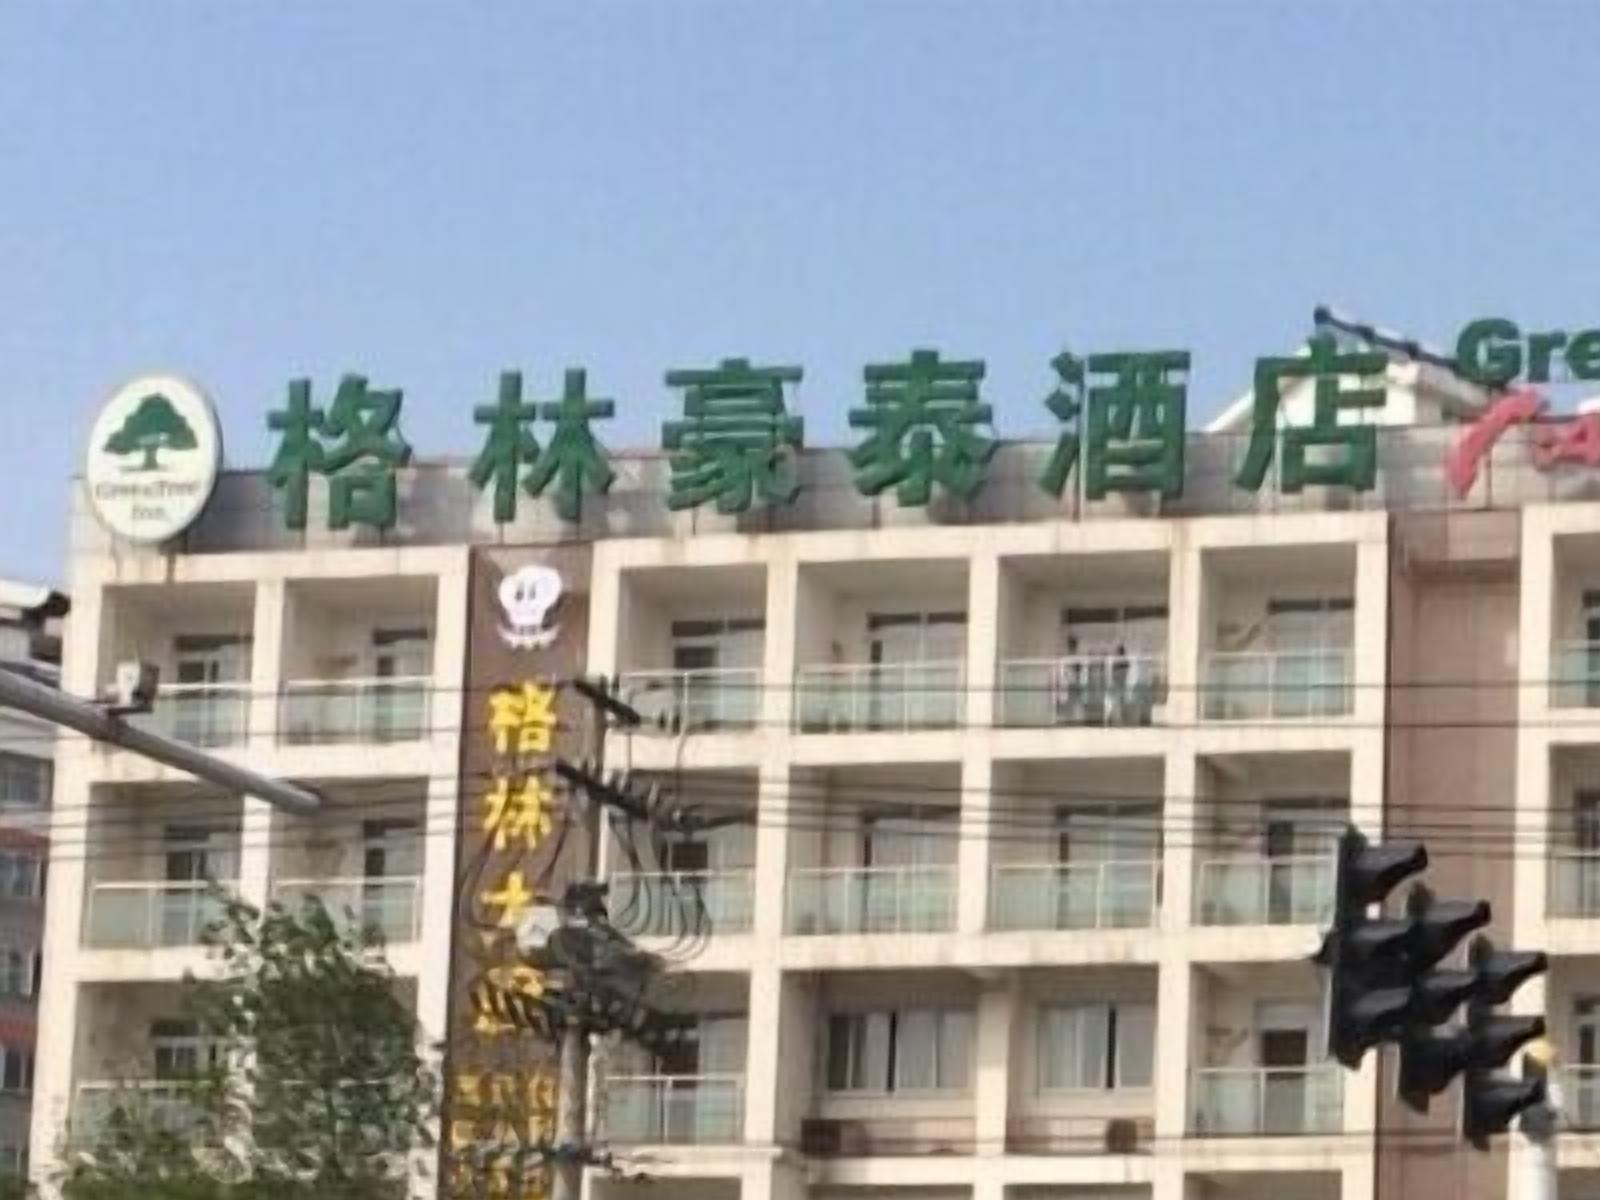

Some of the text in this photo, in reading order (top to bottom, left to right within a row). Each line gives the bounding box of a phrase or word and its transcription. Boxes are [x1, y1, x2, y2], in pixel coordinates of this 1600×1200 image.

[266, 331, 1390, 531] 格林豪泰酒店
